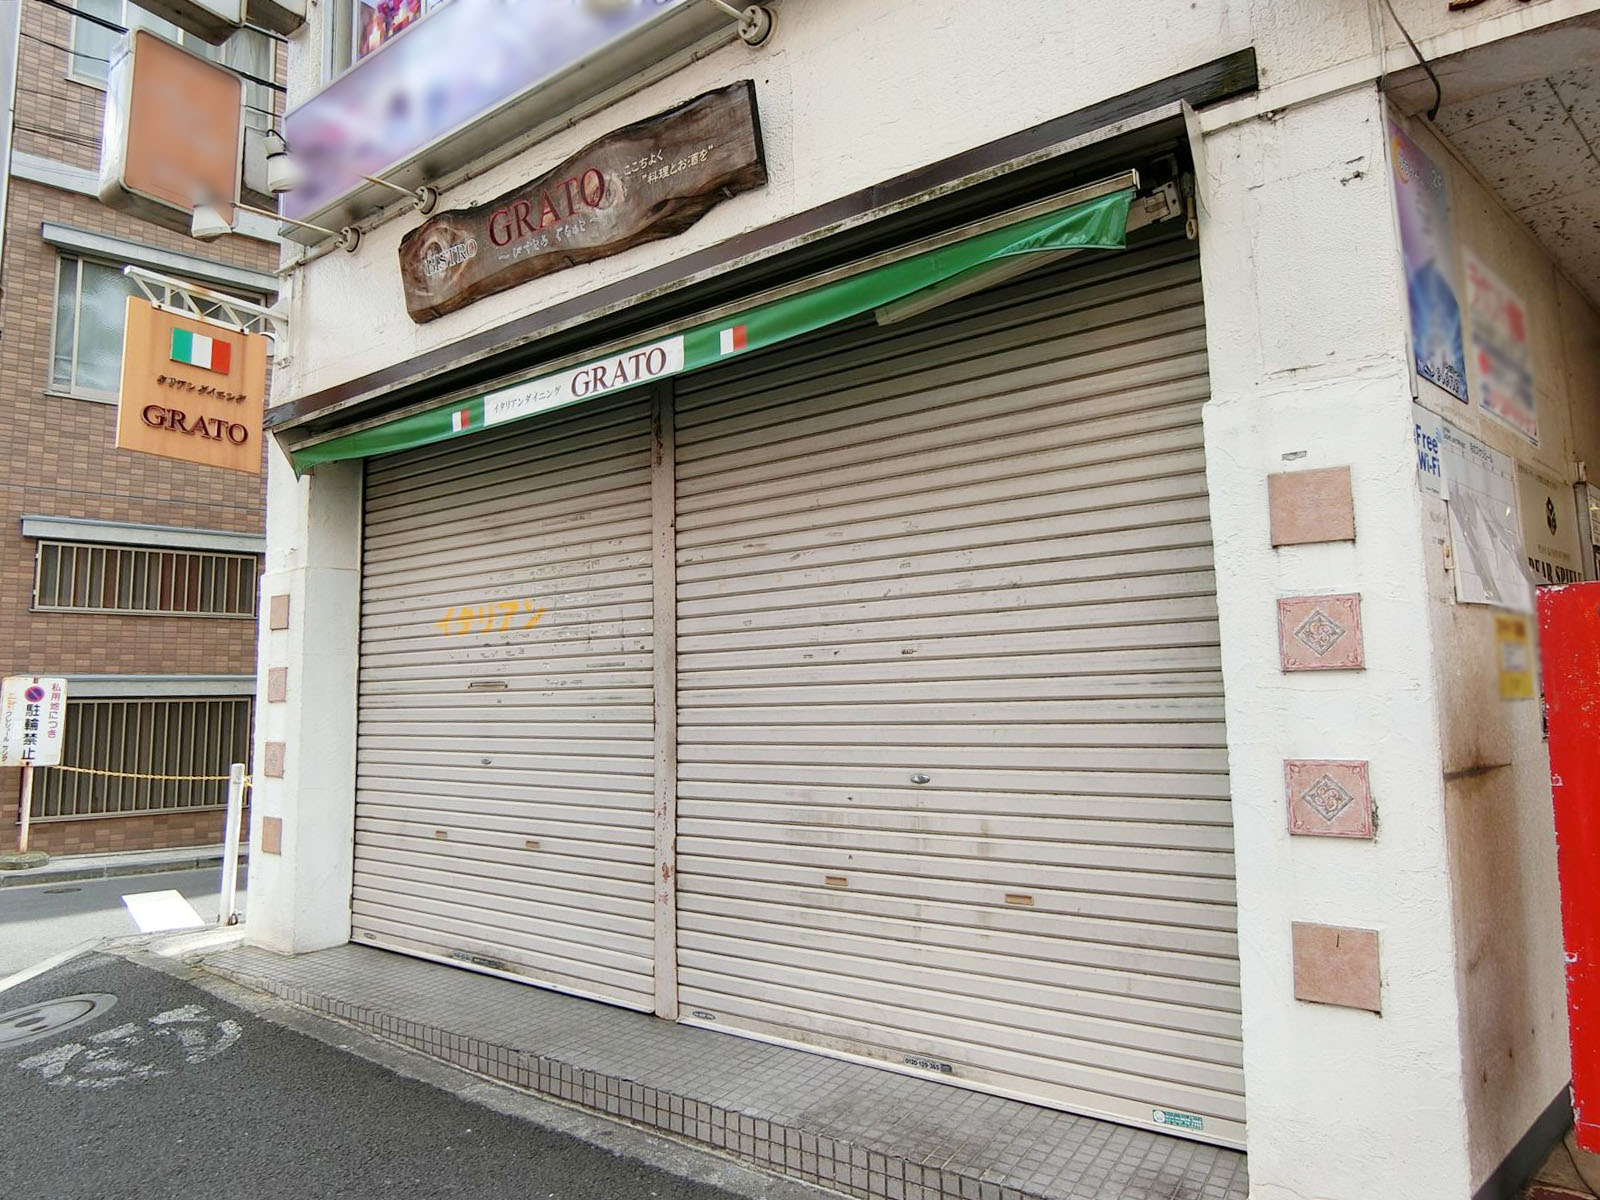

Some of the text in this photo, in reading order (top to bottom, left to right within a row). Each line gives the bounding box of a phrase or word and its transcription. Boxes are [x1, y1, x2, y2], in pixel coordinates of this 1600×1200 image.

[624, 149, 663, 176] ここちよく
[425, 167, 605, 277] BISTRO GRATO
[571, 347, 667, 398] GRATO
[494, 385, 562, 414] イタリアンダイニング
[141, 404, 249, 446] GRATO
[1414, 423, 1438, 454] Free
[1418, 449, 1441, 478] Wi-Fi
[434, 598, 545, 636] イタリアン
[21, 703, 41, 760] 駐輪禁止
